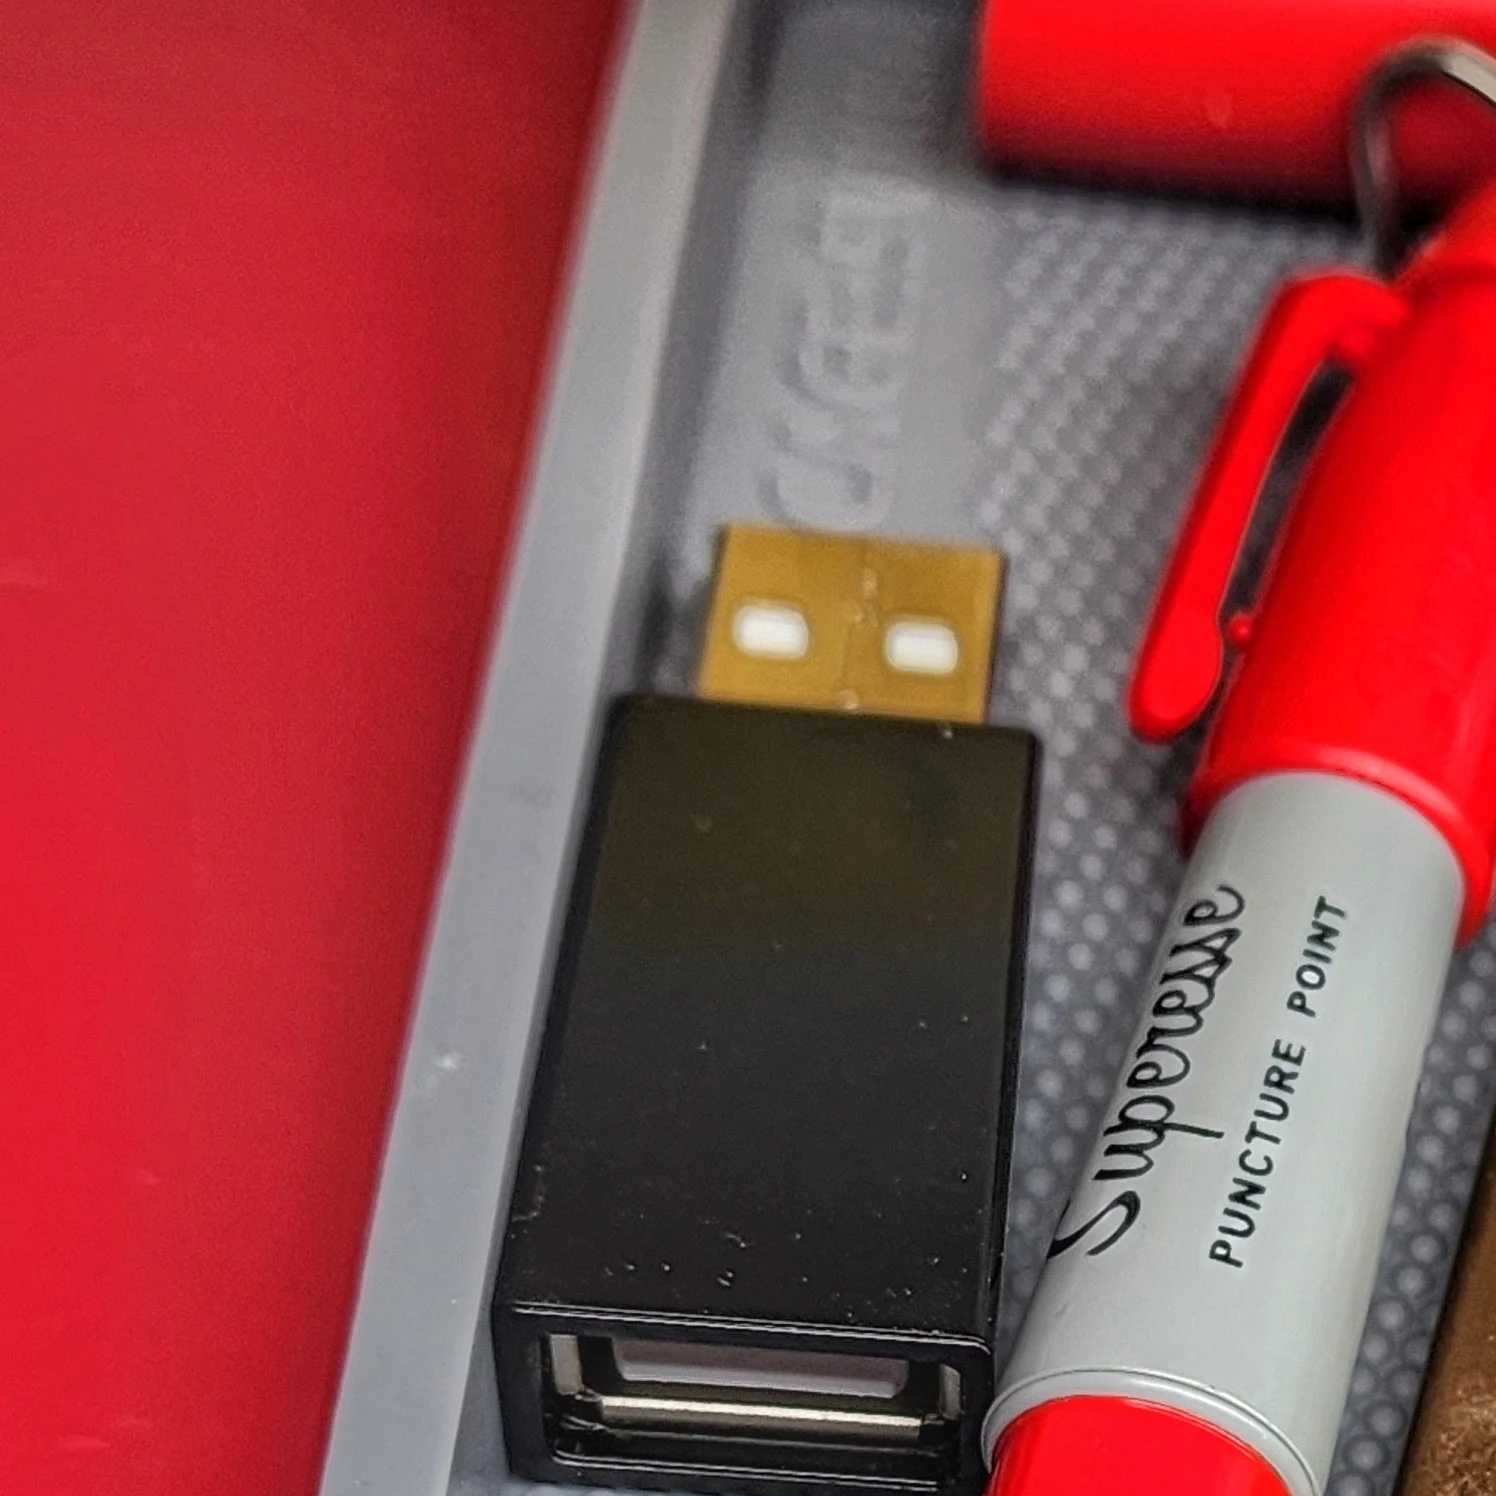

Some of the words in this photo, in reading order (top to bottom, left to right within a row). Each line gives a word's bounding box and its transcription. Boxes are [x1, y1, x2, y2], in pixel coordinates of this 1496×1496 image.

[1046, 884, 1246, 1259] Superesse
[1208, 1038, 1306, 1268] PUNCTURE
[1286, 894, 1348, 1018] POINT
